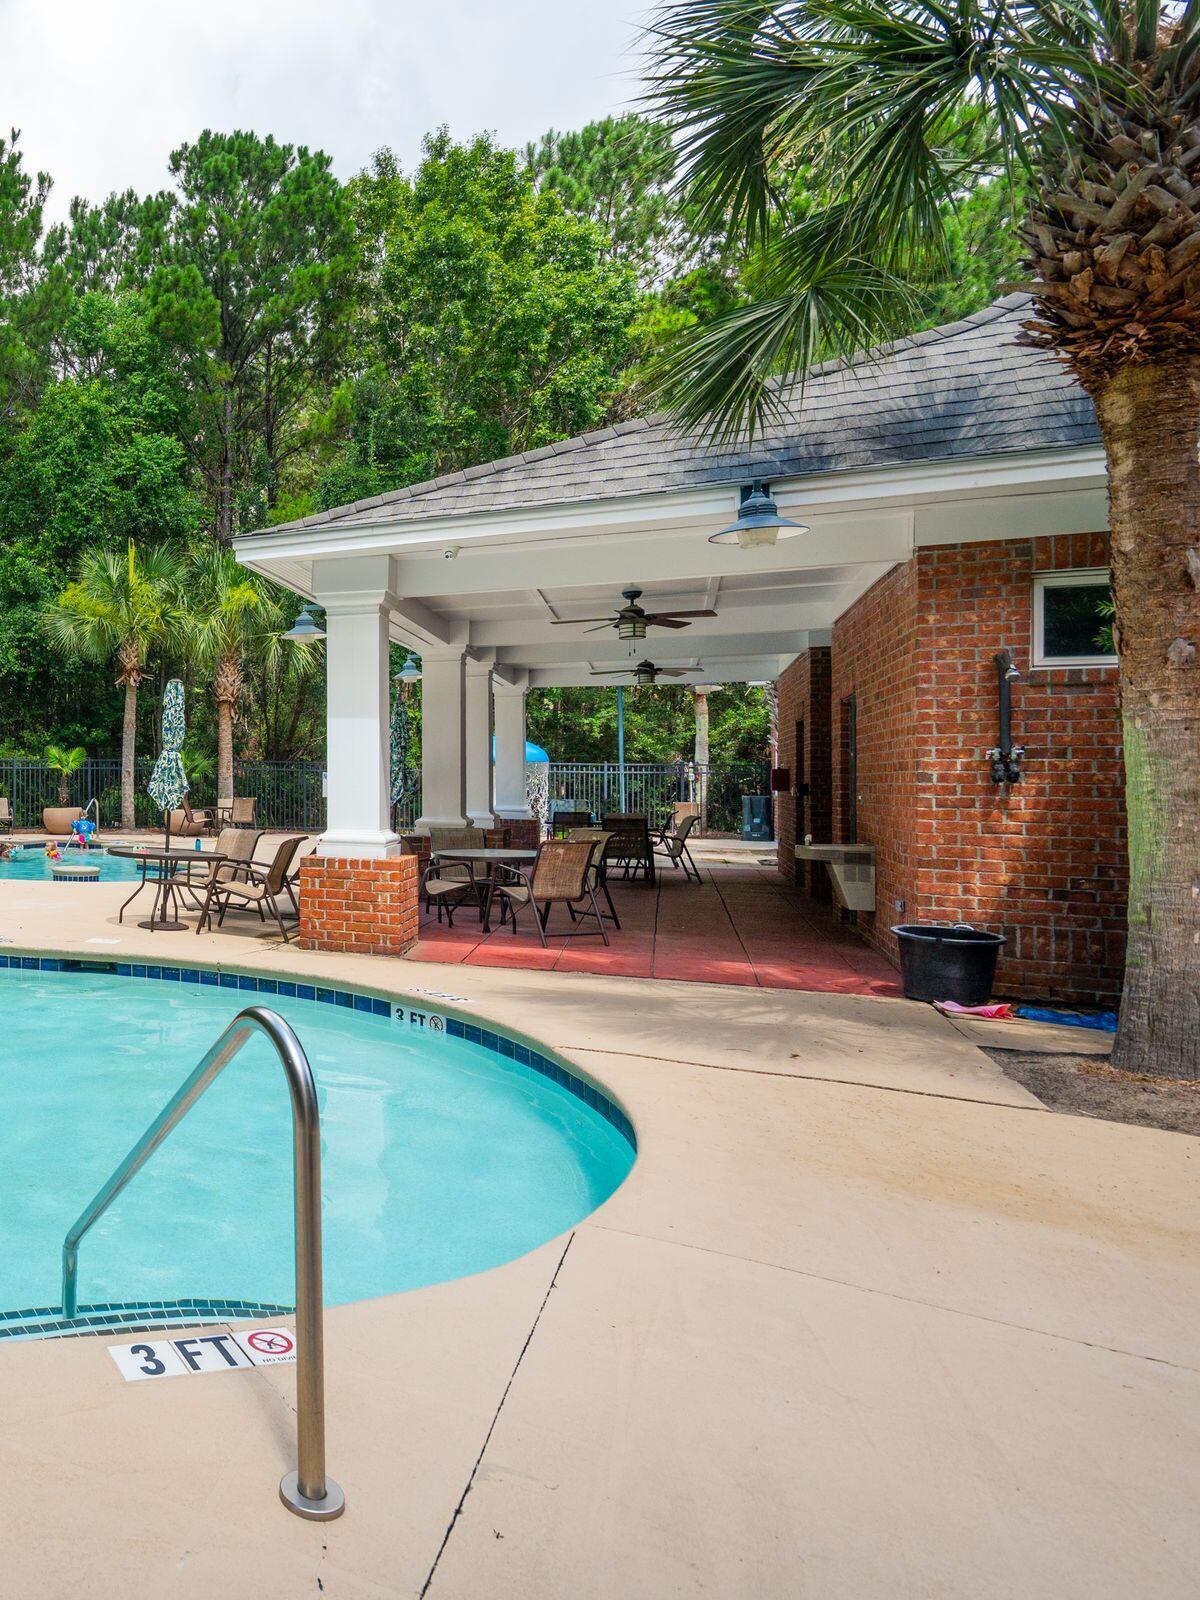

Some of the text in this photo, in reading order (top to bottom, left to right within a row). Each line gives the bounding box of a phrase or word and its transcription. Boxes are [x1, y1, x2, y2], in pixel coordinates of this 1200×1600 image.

[395, 1008, 426, 1026] 3 FT
[130, 1335, 239, 1376] 3 FT
